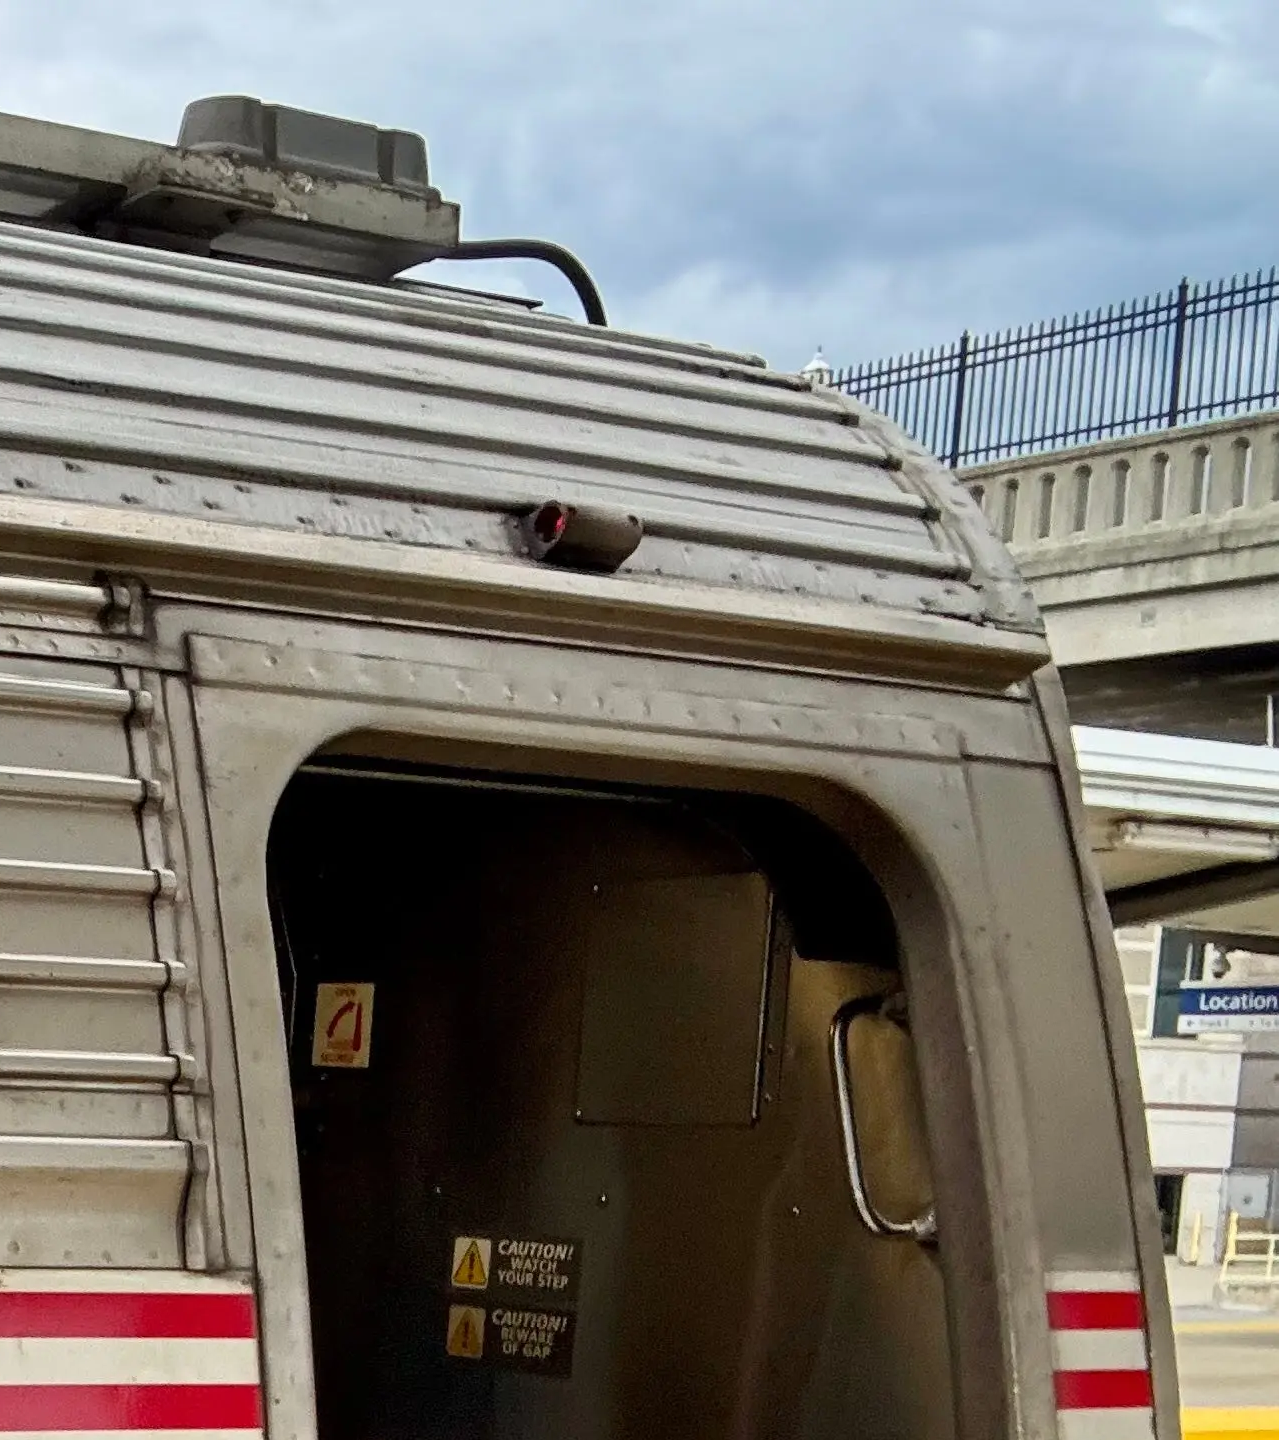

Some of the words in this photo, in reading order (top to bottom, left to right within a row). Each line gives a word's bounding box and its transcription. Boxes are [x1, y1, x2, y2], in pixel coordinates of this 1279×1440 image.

[1199, 991, 1279, 1011] Location
[497, 1238, 575, 1262] CAUTION!
[511, 1256, 557, 1274] WATCH
[498, 1270, 533, 1287] YOUR
[539, 1274, 569, 1290] STEP
[491, 1308, 568, 1333] CAUTION!
